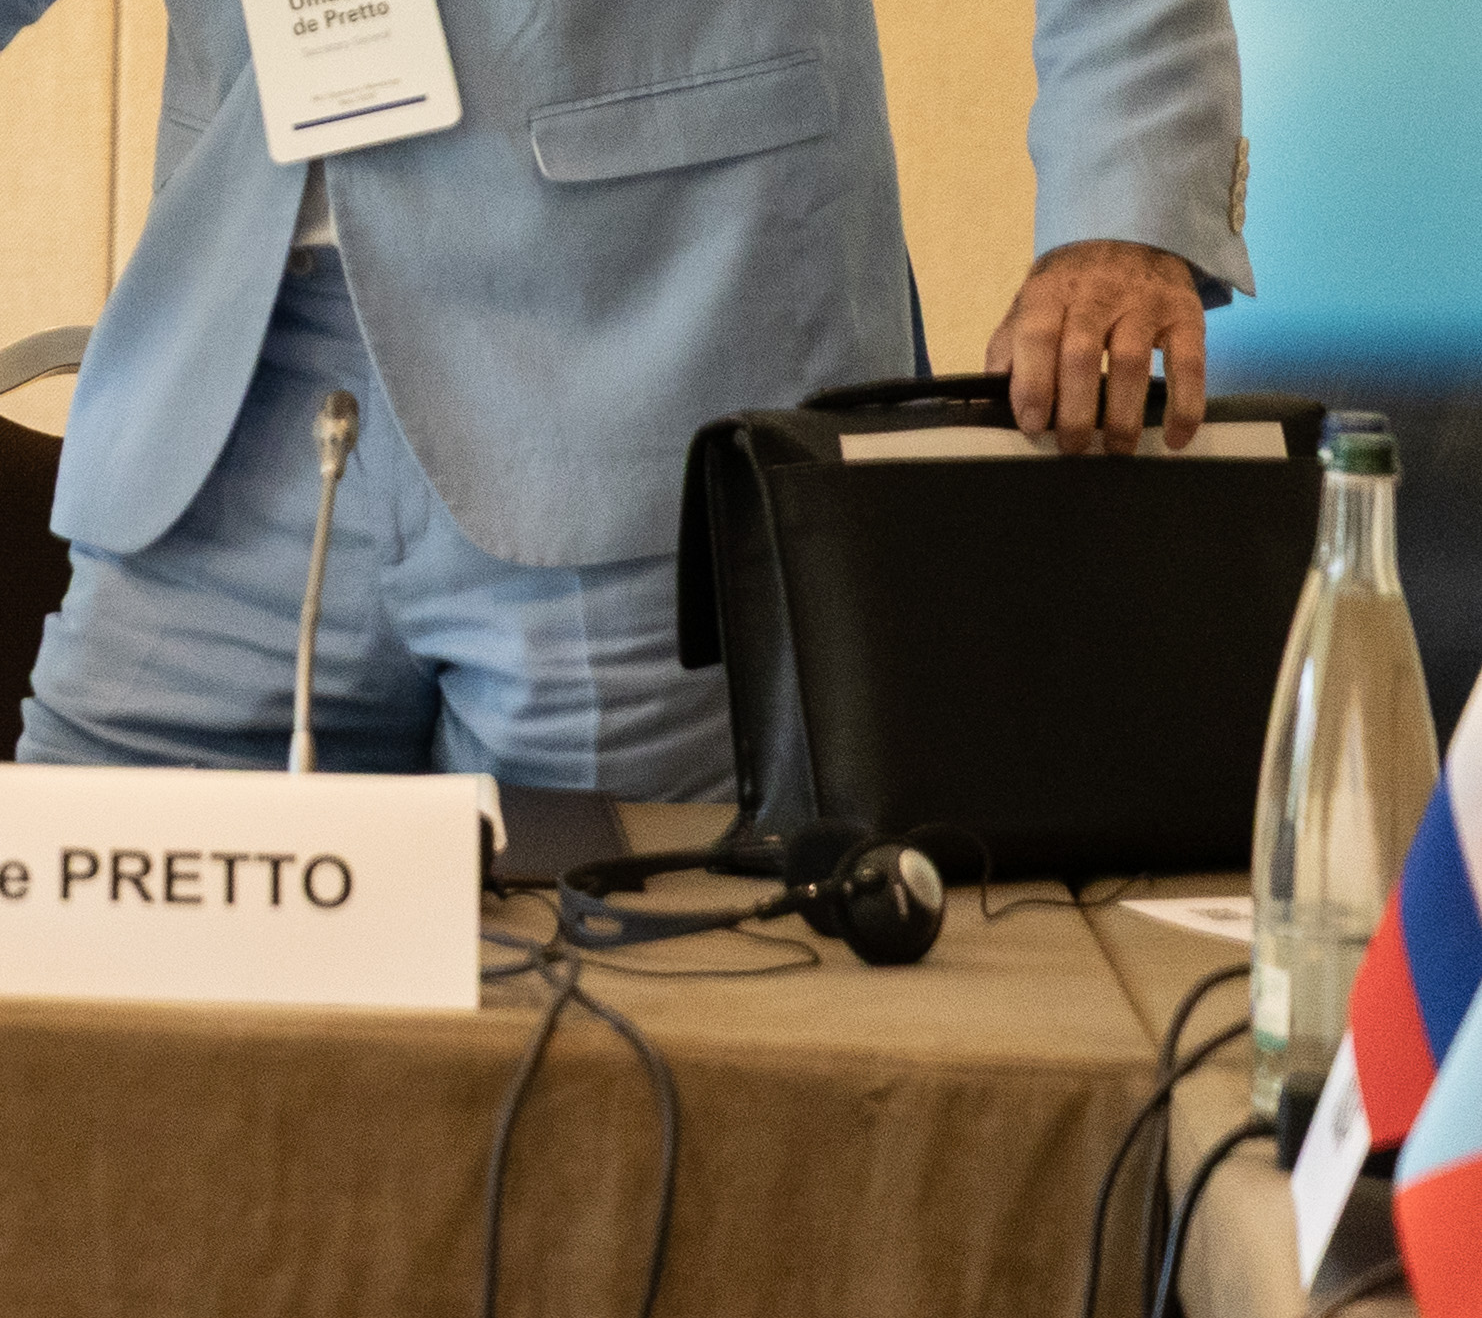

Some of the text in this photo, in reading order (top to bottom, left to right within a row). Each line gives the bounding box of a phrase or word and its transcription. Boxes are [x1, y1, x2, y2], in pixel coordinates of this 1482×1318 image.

[293, 0, 390, 36] de Pretto
[59, 846, 353, 908] PRETTO
